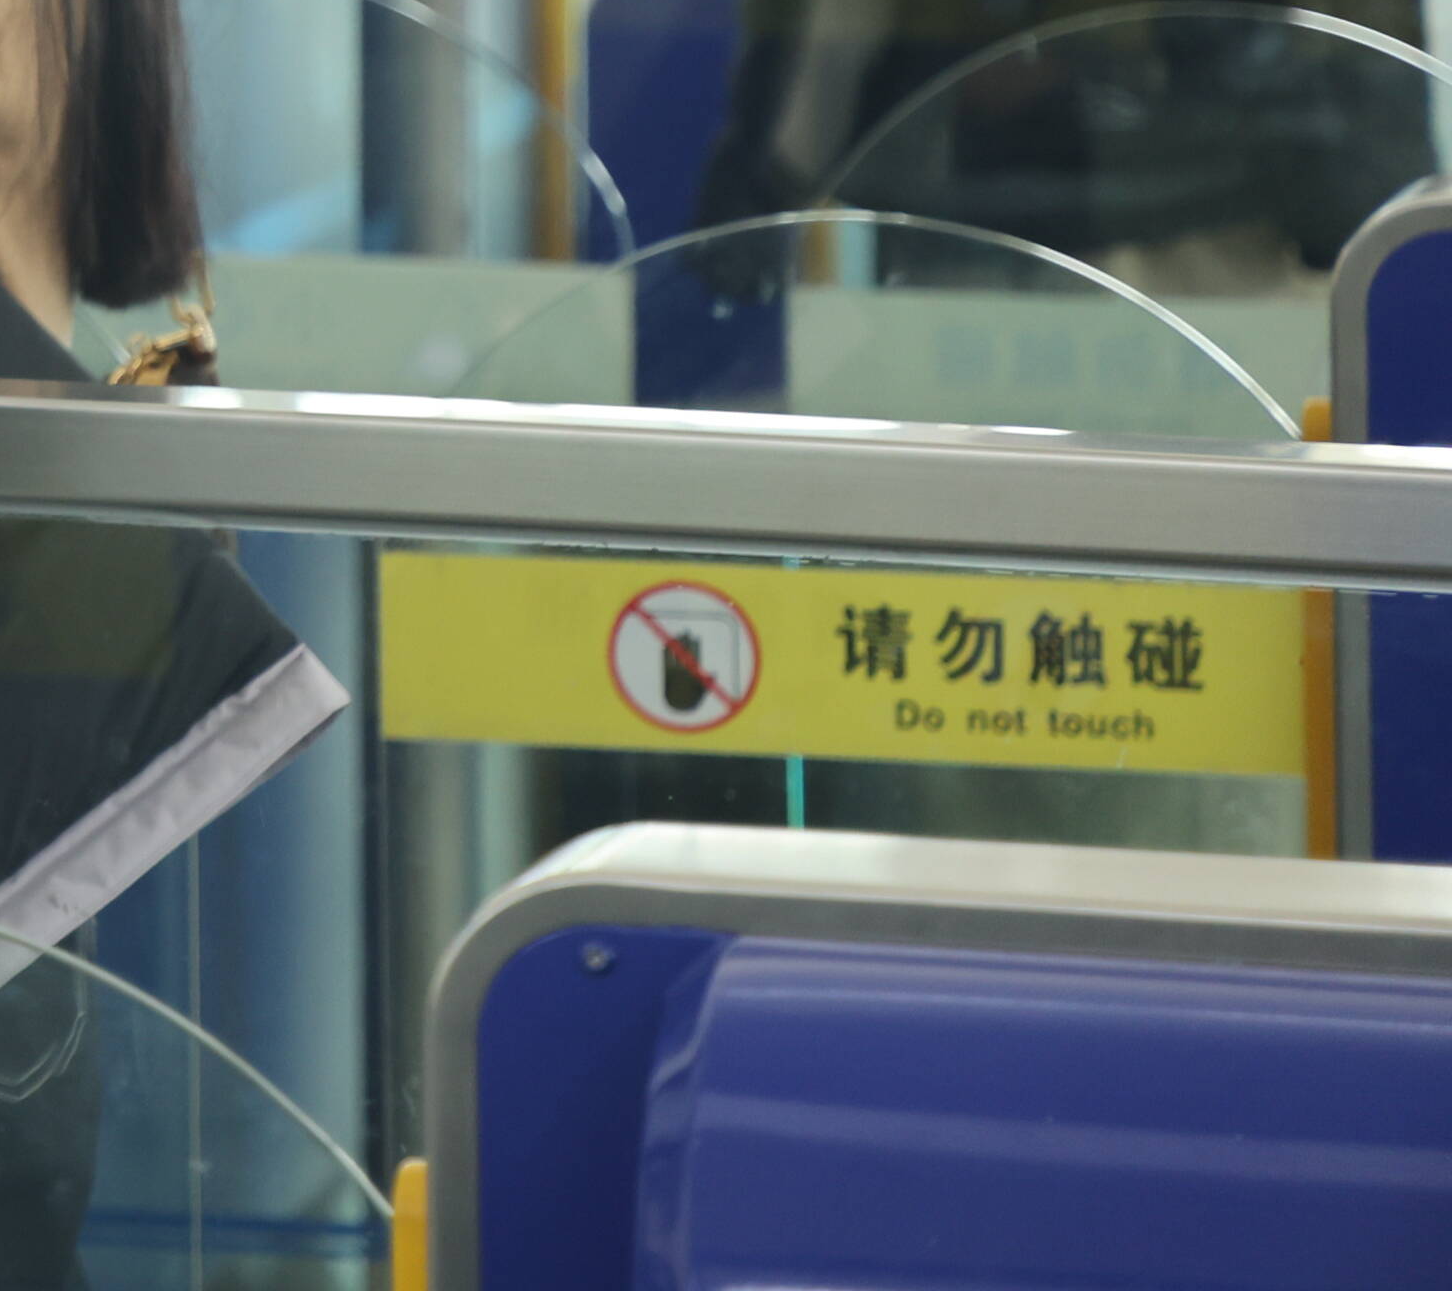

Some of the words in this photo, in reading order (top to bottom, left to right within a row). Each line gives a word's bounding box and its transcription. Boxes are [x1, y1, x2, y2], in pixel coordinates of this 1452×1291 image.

[835, 603, 1205, 691] 请勿触碰
[895, 697, 945, 732] Do
[966, 707, 1026, 736] not
[1047, 707, 1156, 739] touch
